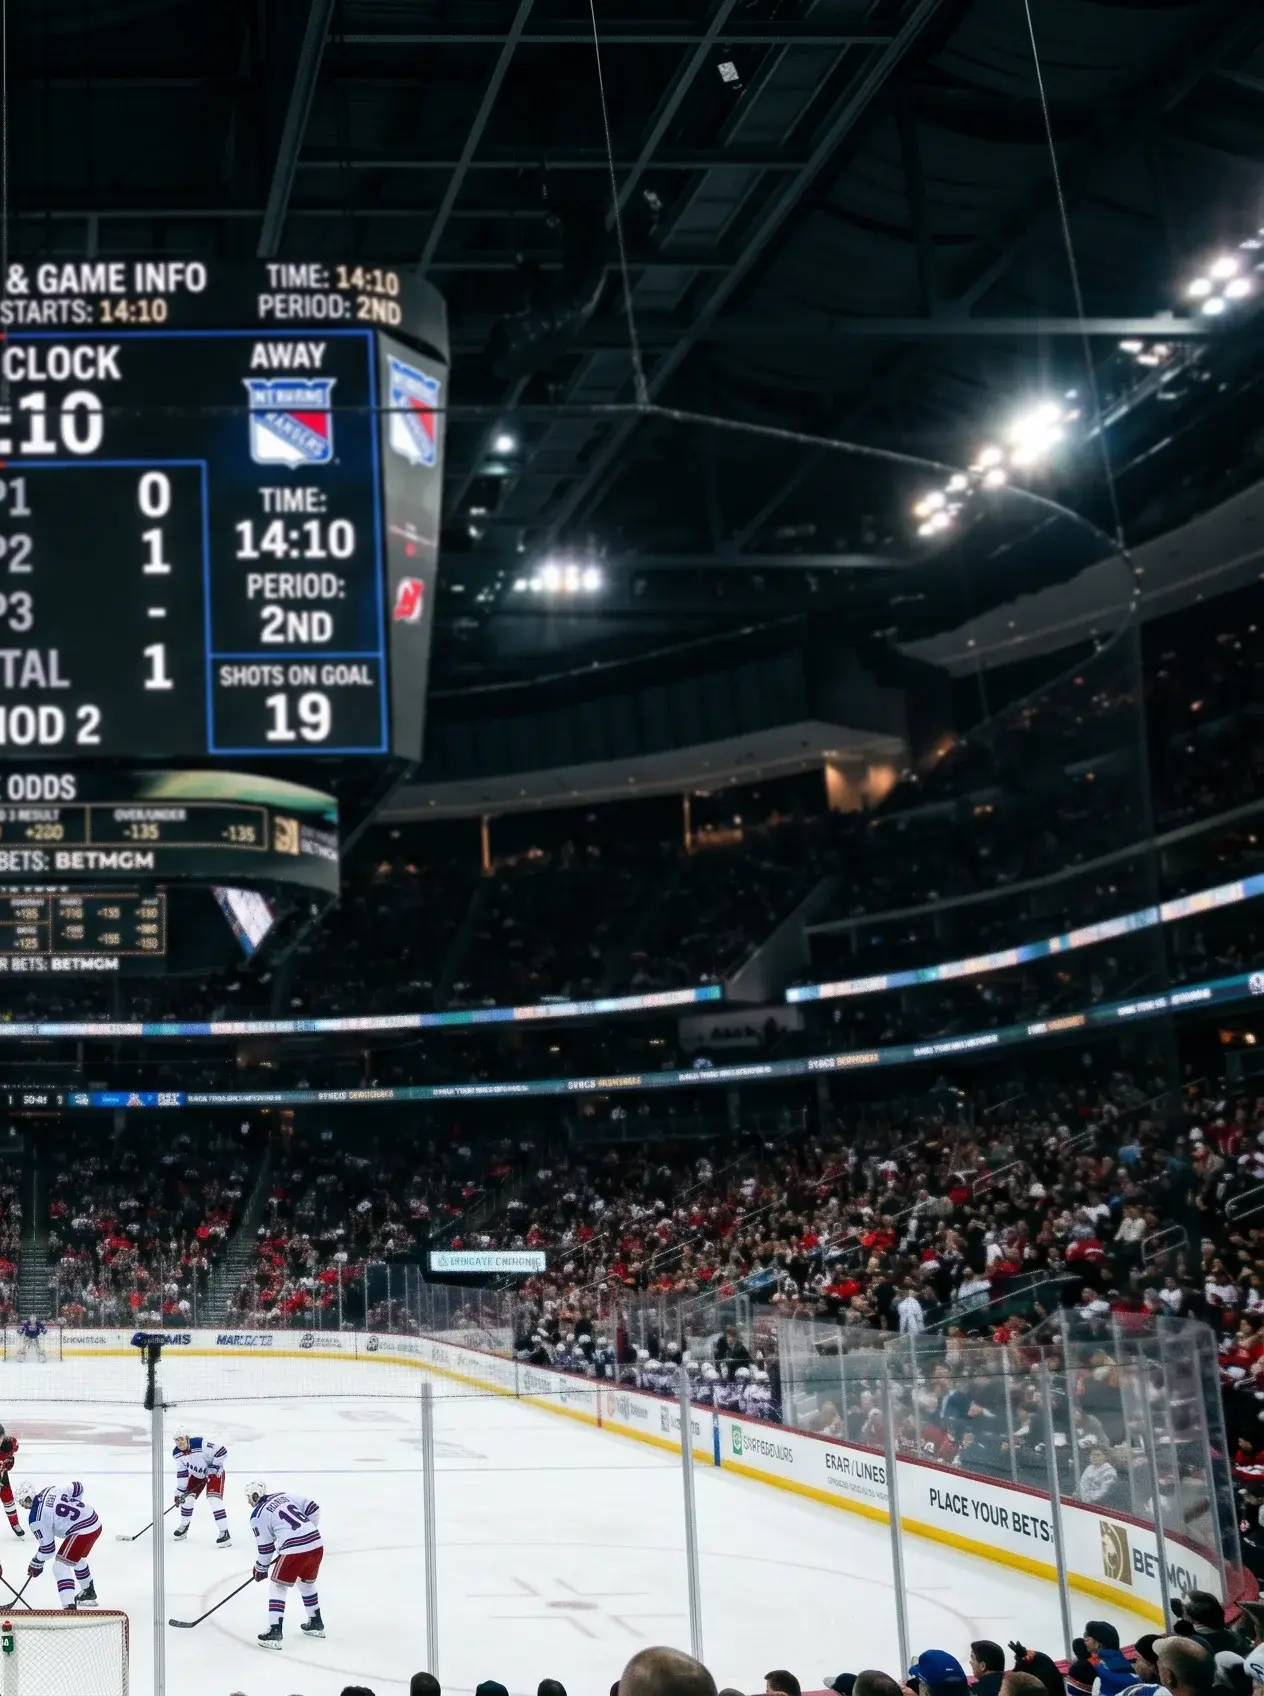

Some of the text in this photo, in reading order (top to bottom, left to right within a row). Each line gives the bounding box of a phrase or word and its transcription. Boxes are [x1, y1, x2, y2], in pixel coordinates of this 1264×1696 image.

[6, 263, 30, 294] &
[38, 263, 126, 293] GAME
[136, 262, 206, 293] INFO
[267, 264, 399, 295] TIME: 14:10
[0, 299, 94, 325] STARTS:
[100, 298, 168, 323] 14:10
[258, 294, 402, 325] PERIOD: 2ND
[2, 345, 122, 381] CLOCK
[250, 342, 326, 369] AWAY
[138, 471, 171, 518] 0
[259, 487, 326, 513] TIME:
[142, 529, 171, 574] 1
[235, 519, 355, 559] 14:10
[247, 573, 346, 599] PERIOD:
[260, 606, 333, 643] 2ND
[144, 644, 173, 690] 1
[220, 665, 373, 687] SHOTS ON GOAL
[77, 704, 101, 744] 2
[266, 692, 332, 742] 19
[7, 775, 76, 799] ODDS
[55, 851, 154, 870] BETMGM
[12, 957, 48, 972] BETS:
[51, 957, 119, 972] BETMGM
[278, 1504, 311, 1532] 16
[929, 1487, 970, 1518] PLACE
[971, 1499, 1009, 1530] YOUR
